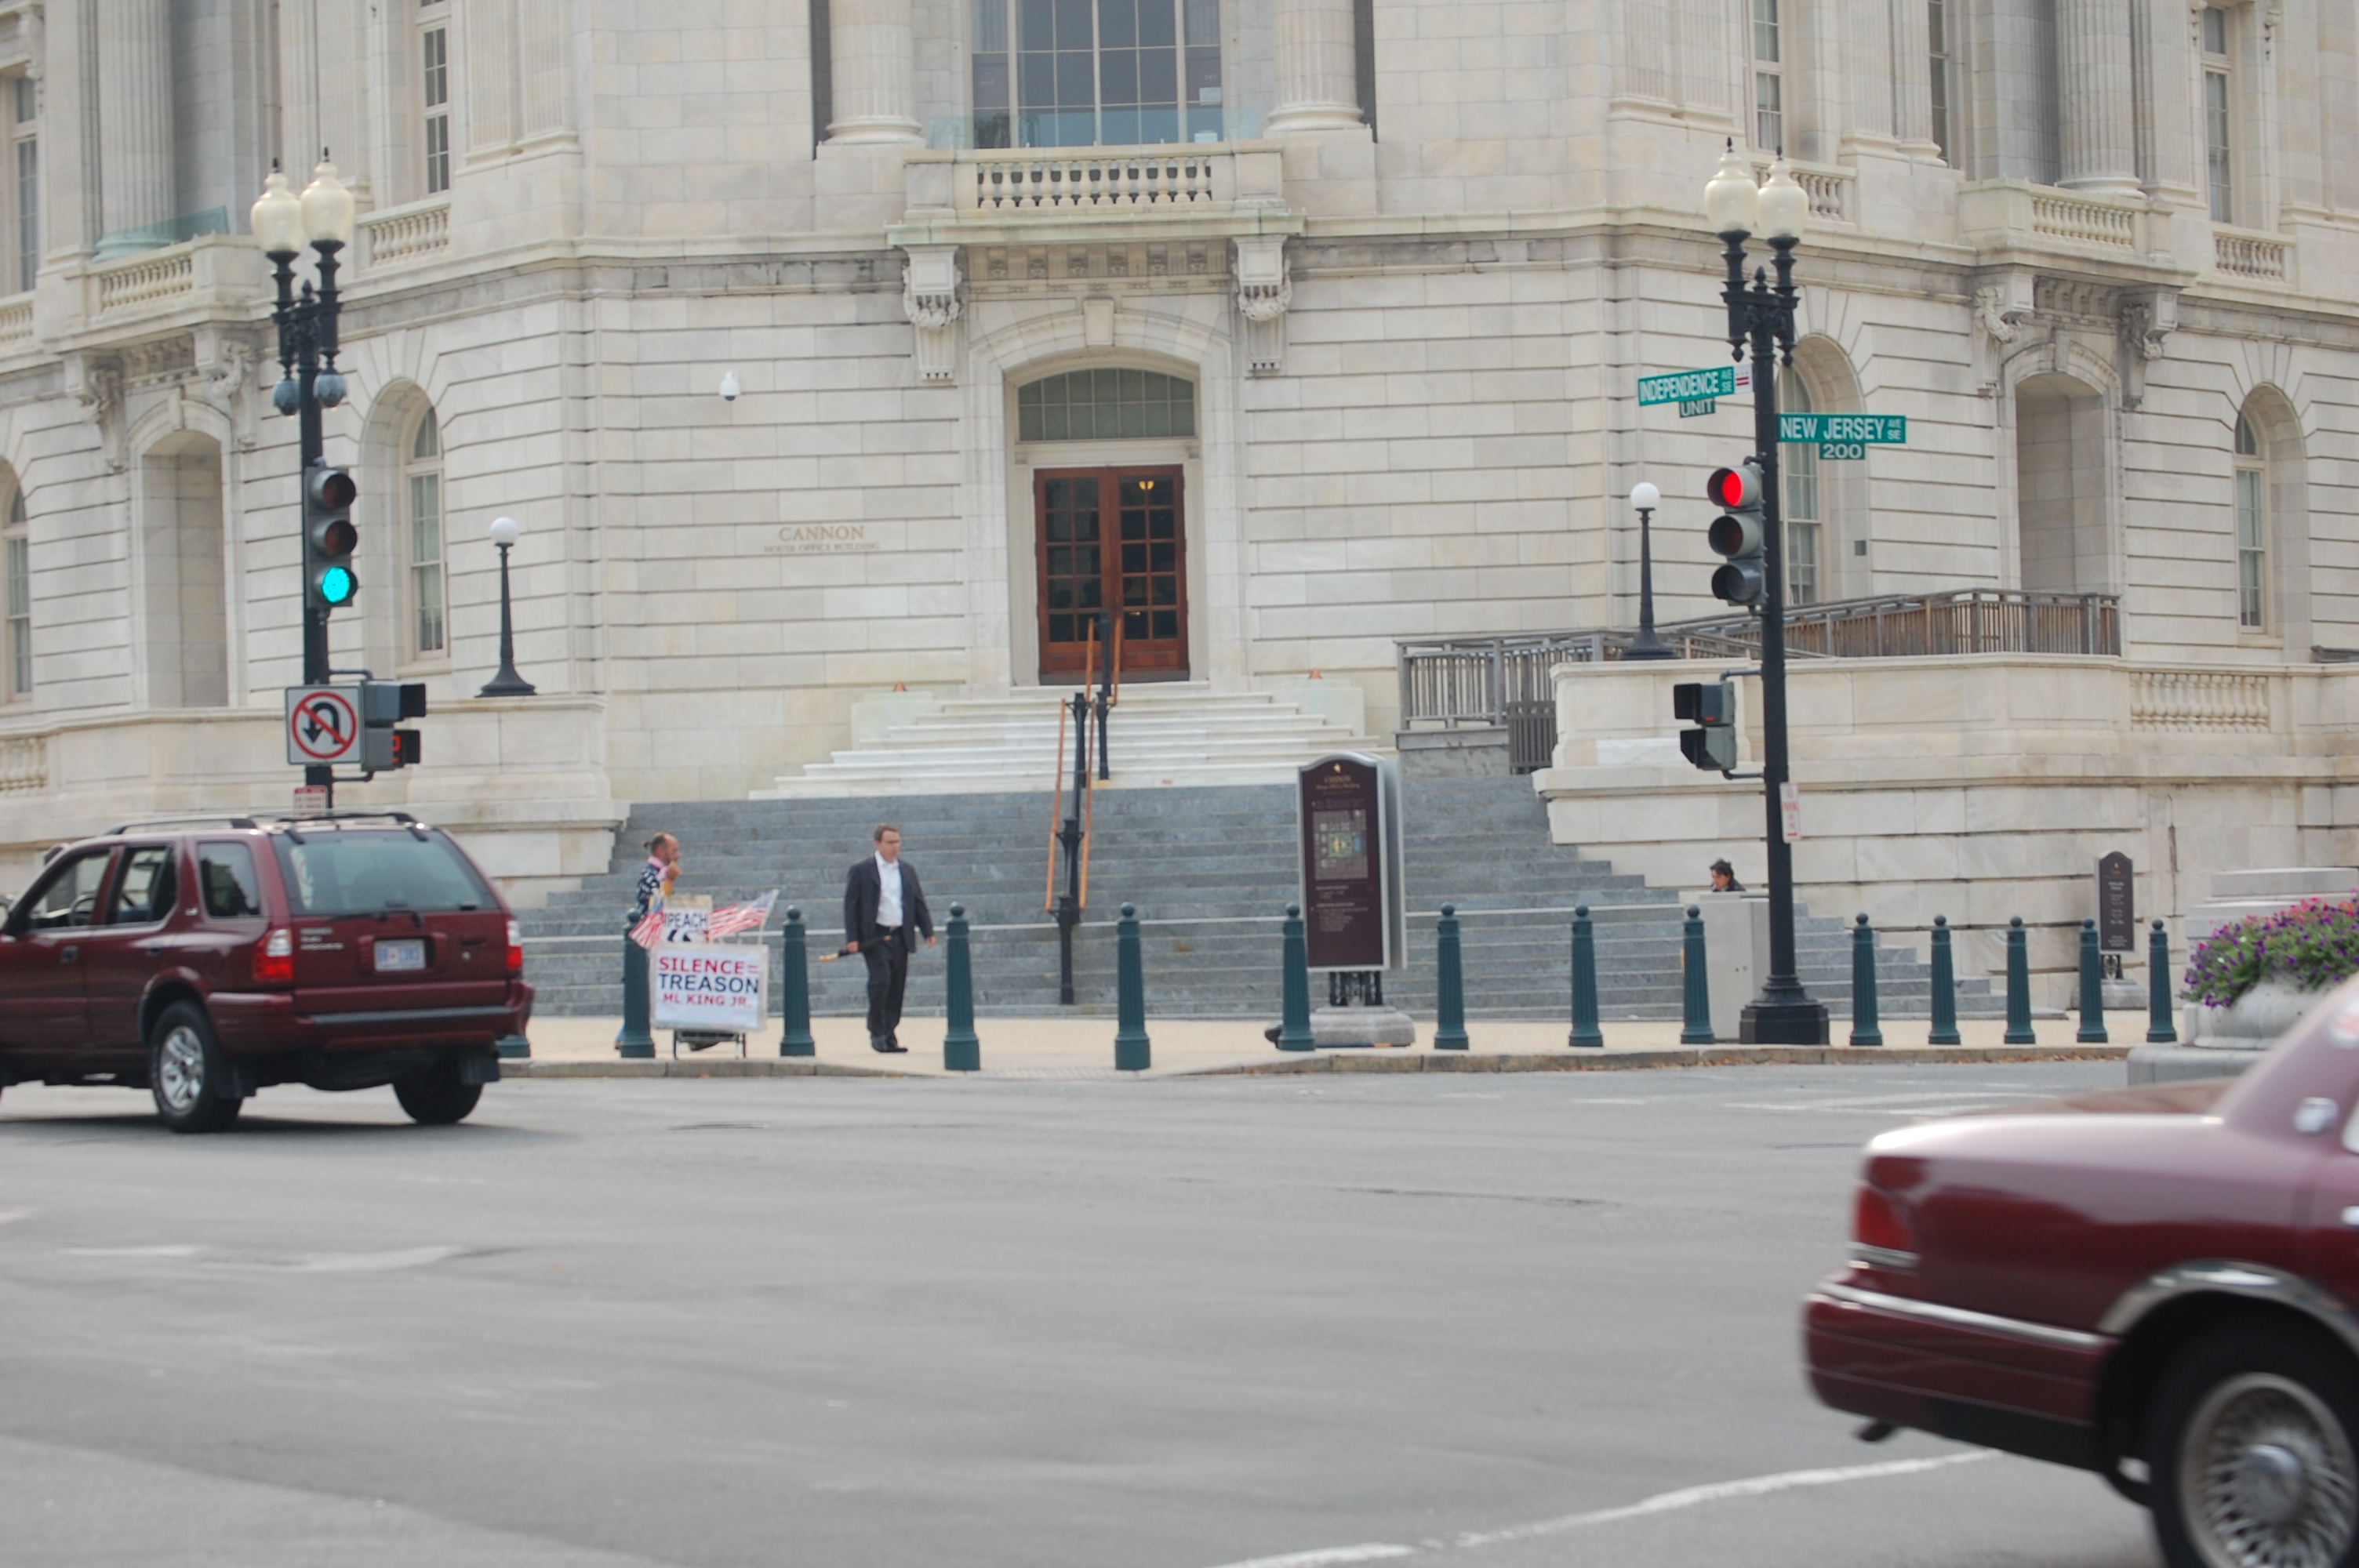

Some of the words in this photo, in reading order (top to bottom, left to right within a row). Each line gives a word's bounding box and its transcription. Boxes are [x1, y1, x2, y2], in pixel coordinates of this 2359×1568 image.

[1639, 372, 1719, 401] INDEPENDENCE
[1681, 398, 1714, 416] UNIT
[1780, 417, 1818, 438] NEW
[1823, 417, 1885, 440] JERSEY
[1887, 419, 1902, 428] AVE
[1887, 429, 1901, 440] SE
[1823, 444, 1862, 459] 200
[778, 525, 864, 541] CANNON
[664, 913, 707, 927] PEACH
[659, 973, 758, 993] TREASON
[686, 993, 724, 1007] KING
